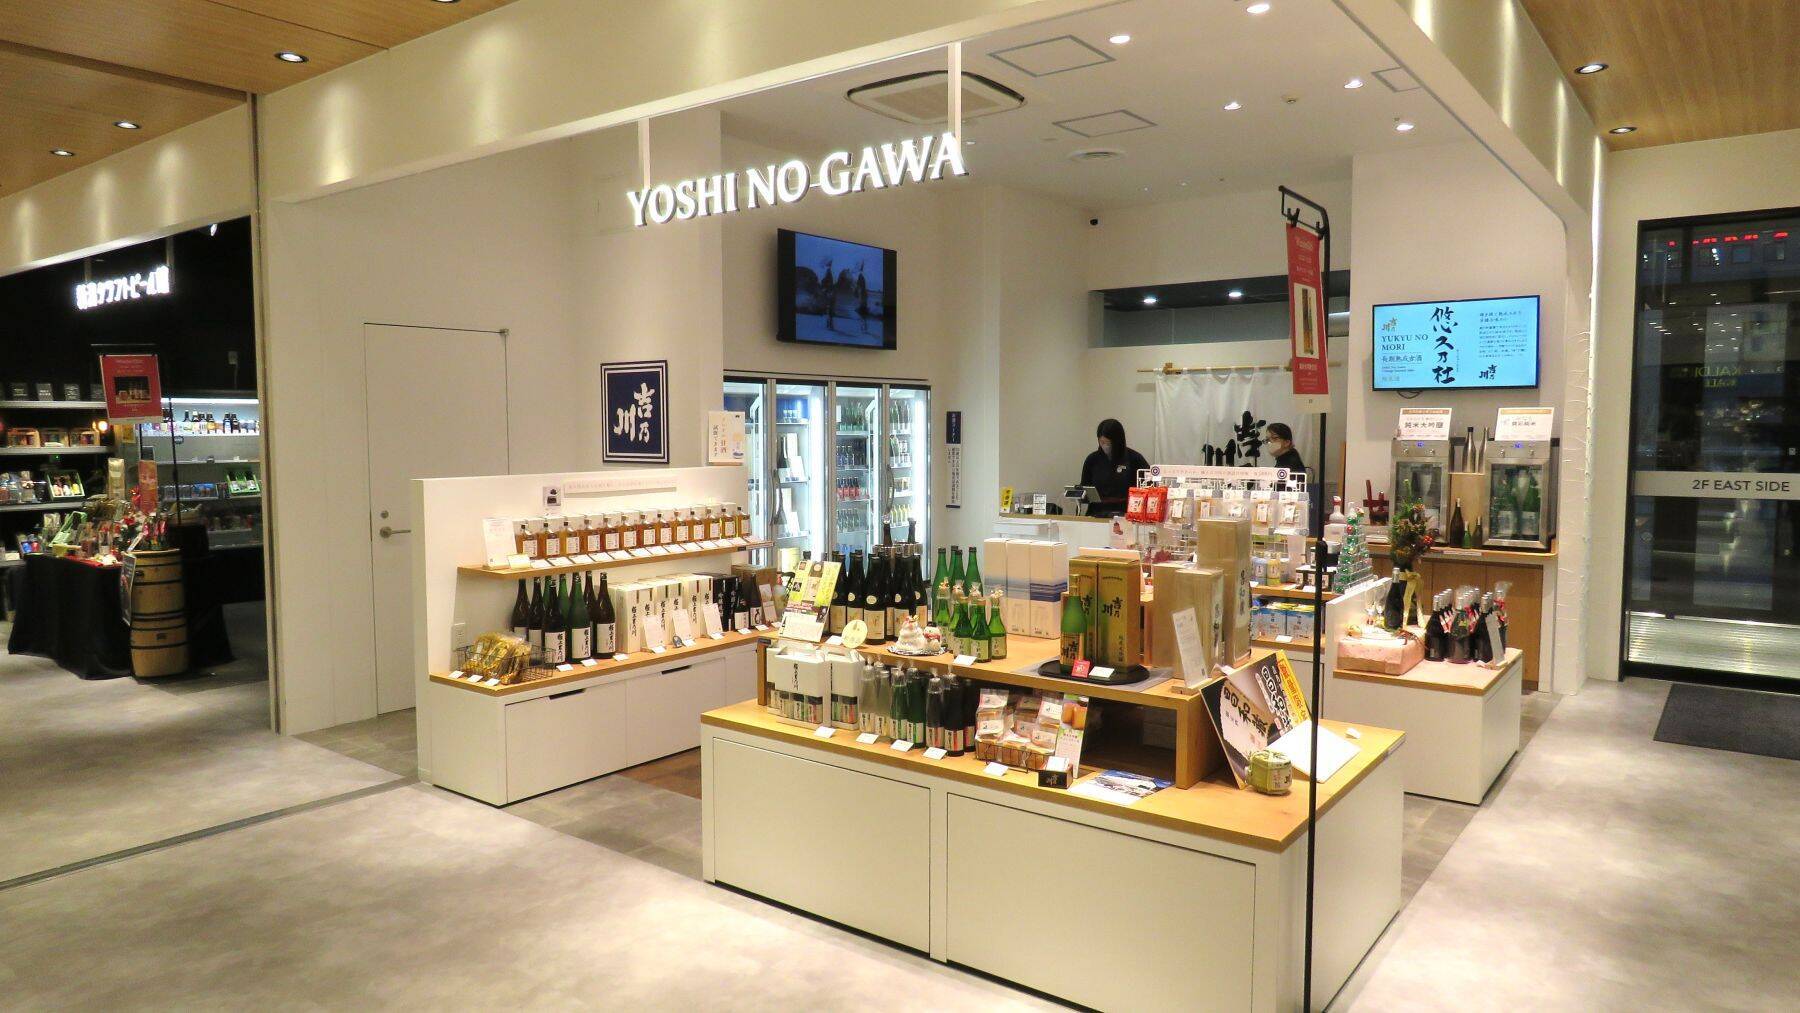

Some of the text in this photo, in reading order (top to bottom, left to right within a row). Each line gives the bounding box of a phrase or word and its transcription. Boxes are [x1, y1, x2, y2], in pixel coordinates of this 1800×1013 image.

[627, 132, 968, 226] YOSHI NO GAWA
[1381, 333, 1429, 342] YUKYU NO
[1381, 343, 1405, 351] MORI
[1692, 479, 1790, 492] 2F EAST SIDE
